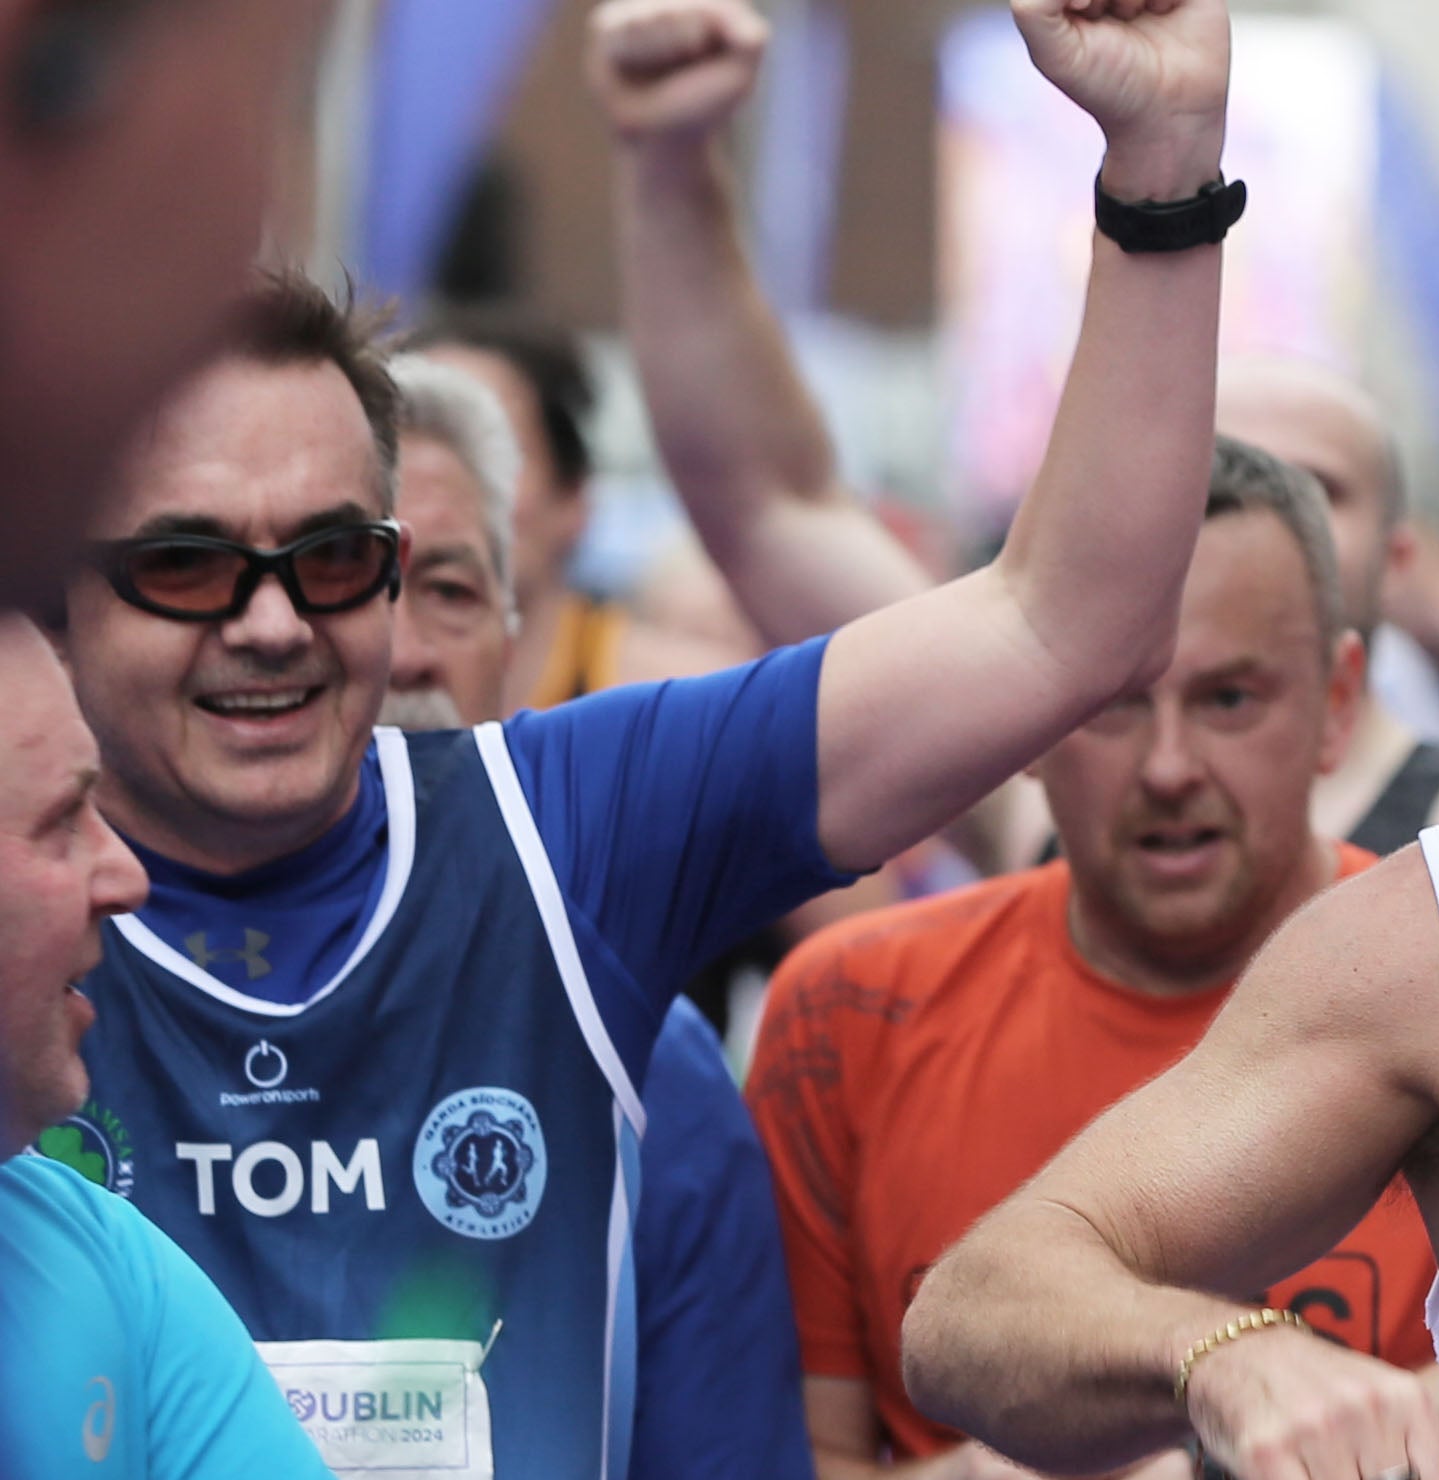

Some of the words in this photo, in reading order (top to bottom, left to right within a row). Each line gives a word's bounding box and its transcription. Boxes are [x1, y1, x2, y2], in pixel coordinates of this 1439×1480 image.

[176, 1138, 386, 1216] TOM
[286, 1389, 443, 1422] DUBLIN
[305, 1425, 397, 1445] ARATHON
[400, 1428, 444, 1444] 2024
